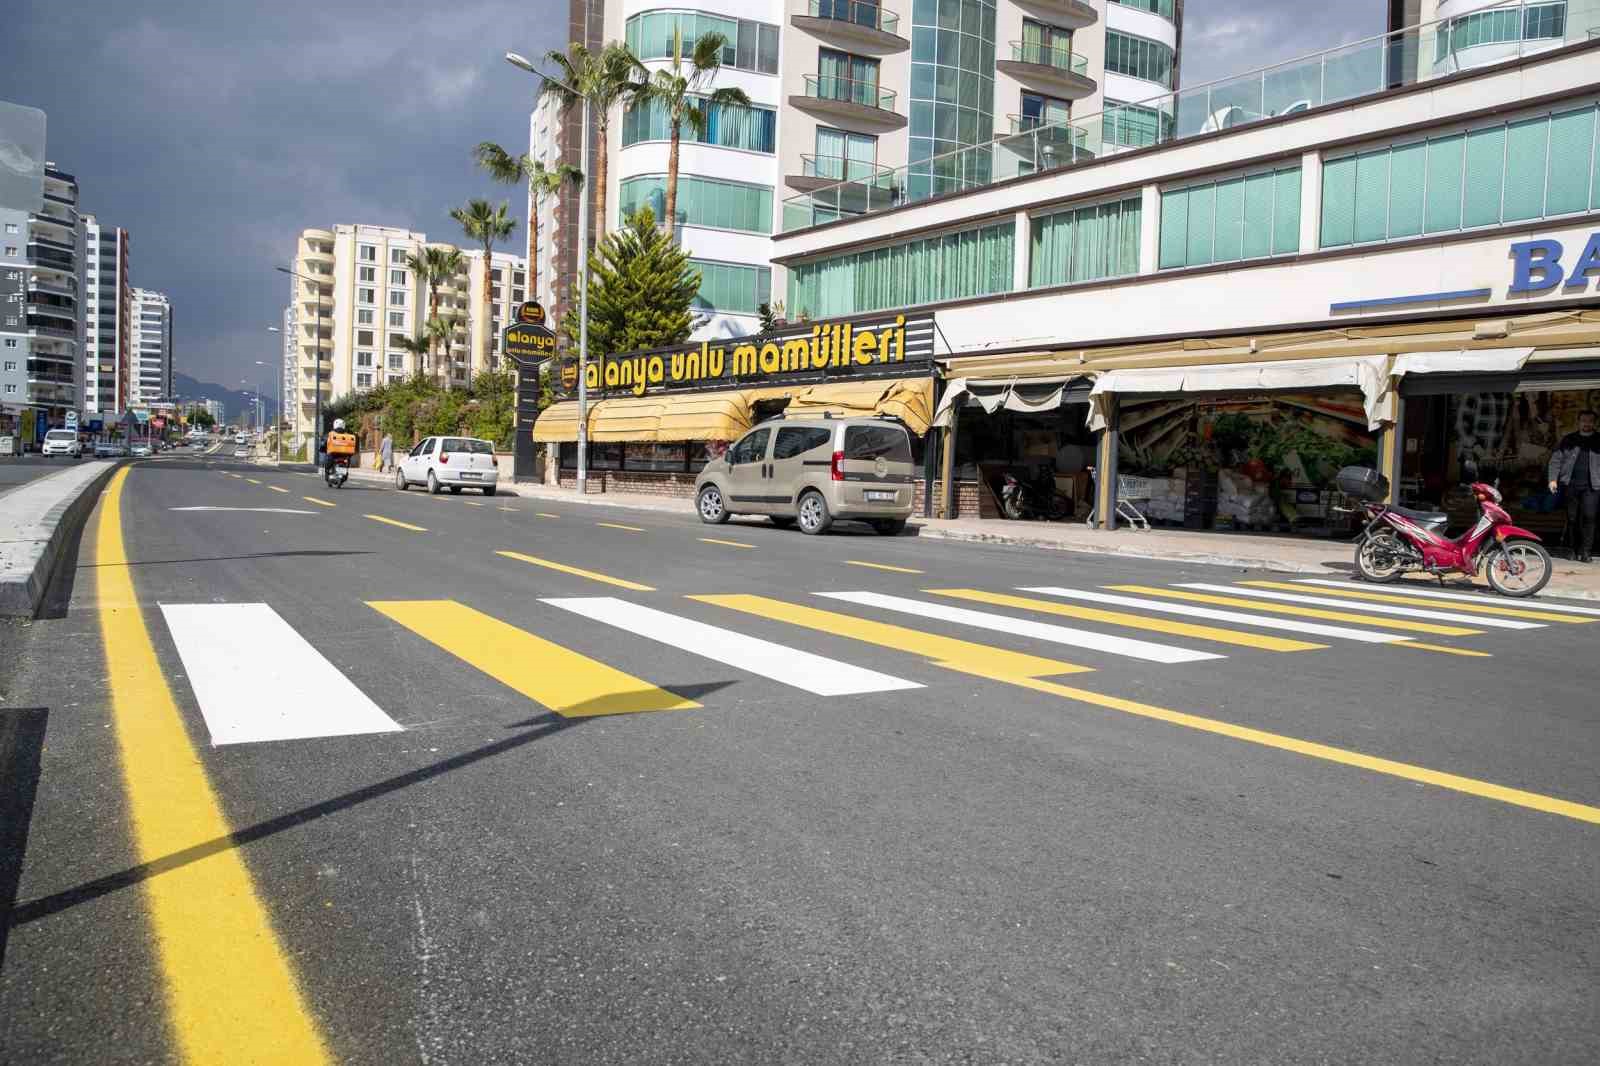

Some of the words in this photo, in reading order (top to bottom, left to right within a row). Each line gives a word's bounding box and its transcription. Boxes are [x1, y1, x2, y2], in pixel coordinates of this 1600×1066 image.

[508, 331, 554, 349] alanya
[585, 352, 664, 397] alanya
[732, 314, 906, 376] mamülleri
